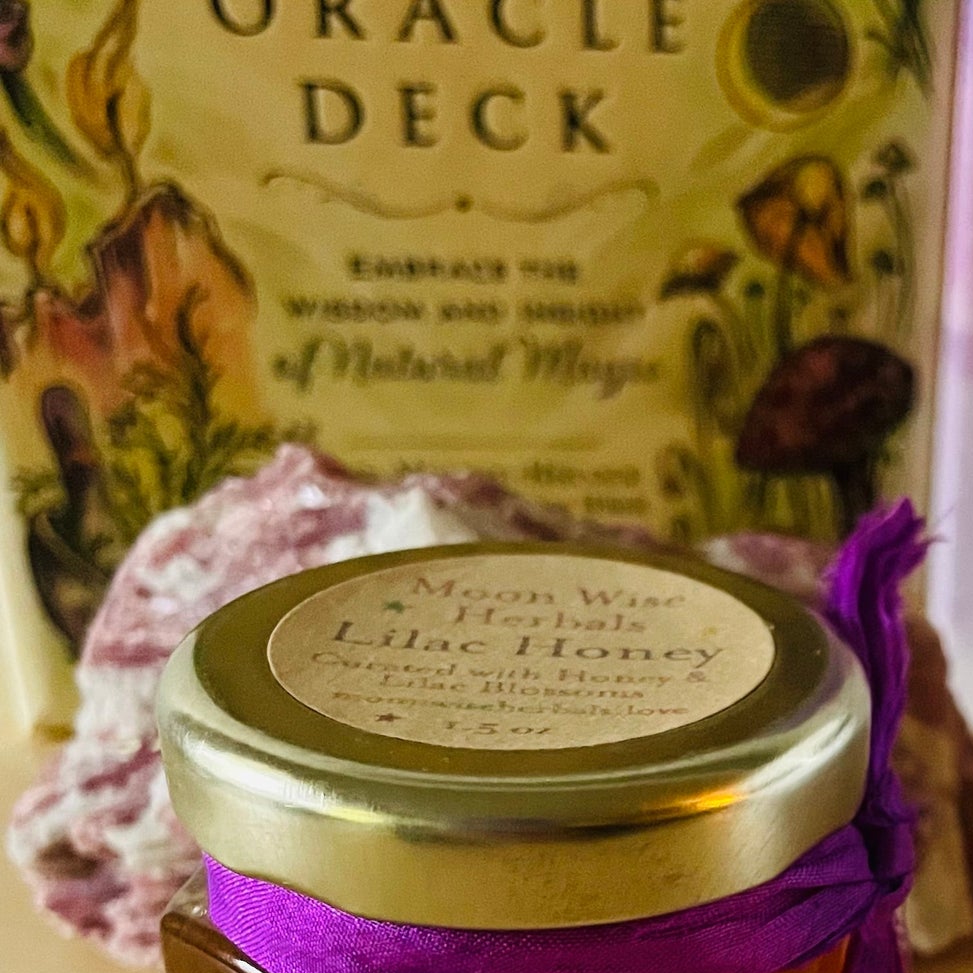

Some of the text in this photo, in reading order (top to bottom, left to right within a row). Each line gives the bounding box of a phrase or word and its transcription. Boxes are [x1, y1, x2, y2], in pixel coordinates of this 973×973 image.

[207, 0, 688, 54] ORACLE
[296, 76, 612, 155] DECK
[411, 576, 687, 609] Moon Wise
[453, 605, 647, 634] Herbals
[330, 621, 724, 669] Lilac Honey
[379, 673, 644, 699] Lilac Blossoms
[469, 668, 541, 683] with
[557, 668, 673, 688] Honey
